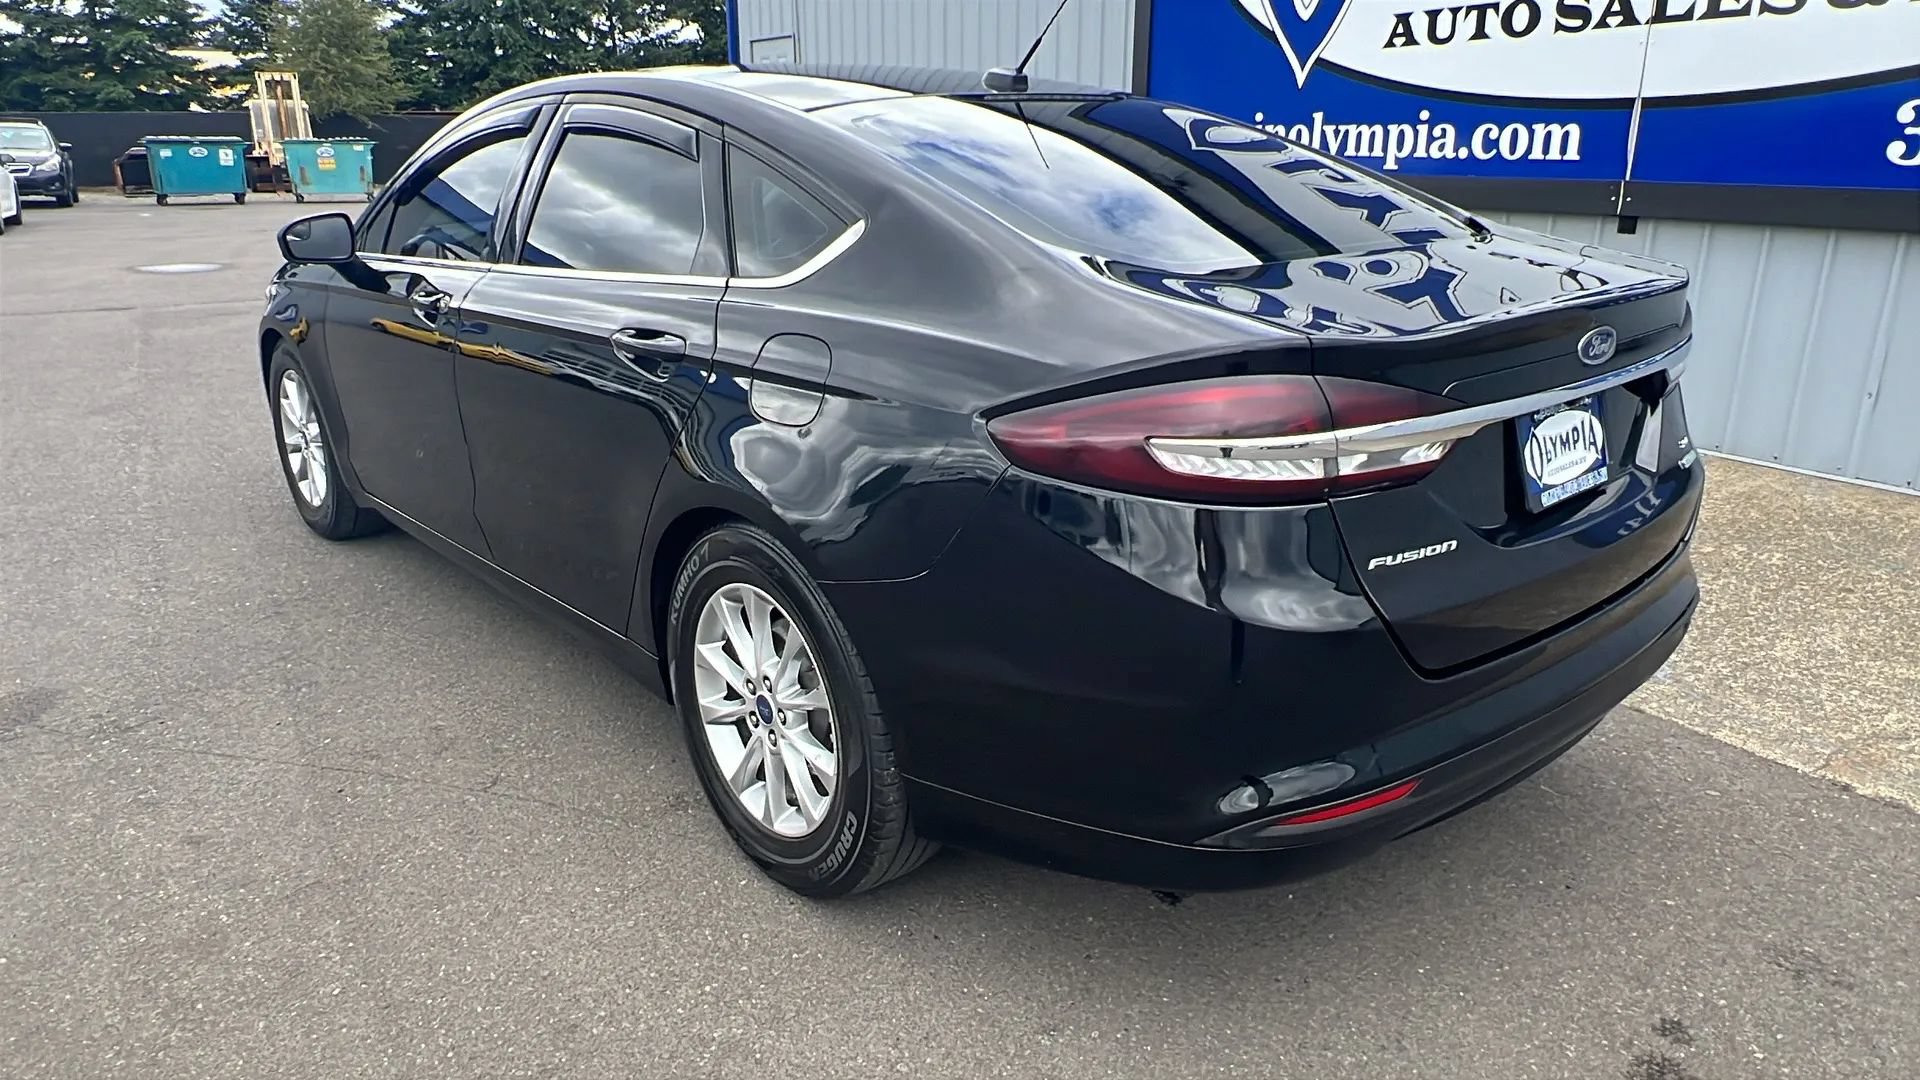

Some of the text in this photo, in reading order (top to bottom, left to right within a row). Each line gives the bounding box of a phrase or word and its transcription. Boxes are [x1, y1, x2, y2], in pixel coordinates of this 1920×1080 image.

[1382, 0, 1541, 49] AUTO
[1530, 411, 1601, 484] OLYMPIA
[1367, 540, 1458, 570] FUSION
[671, 555, 700, 625] KUMHO
